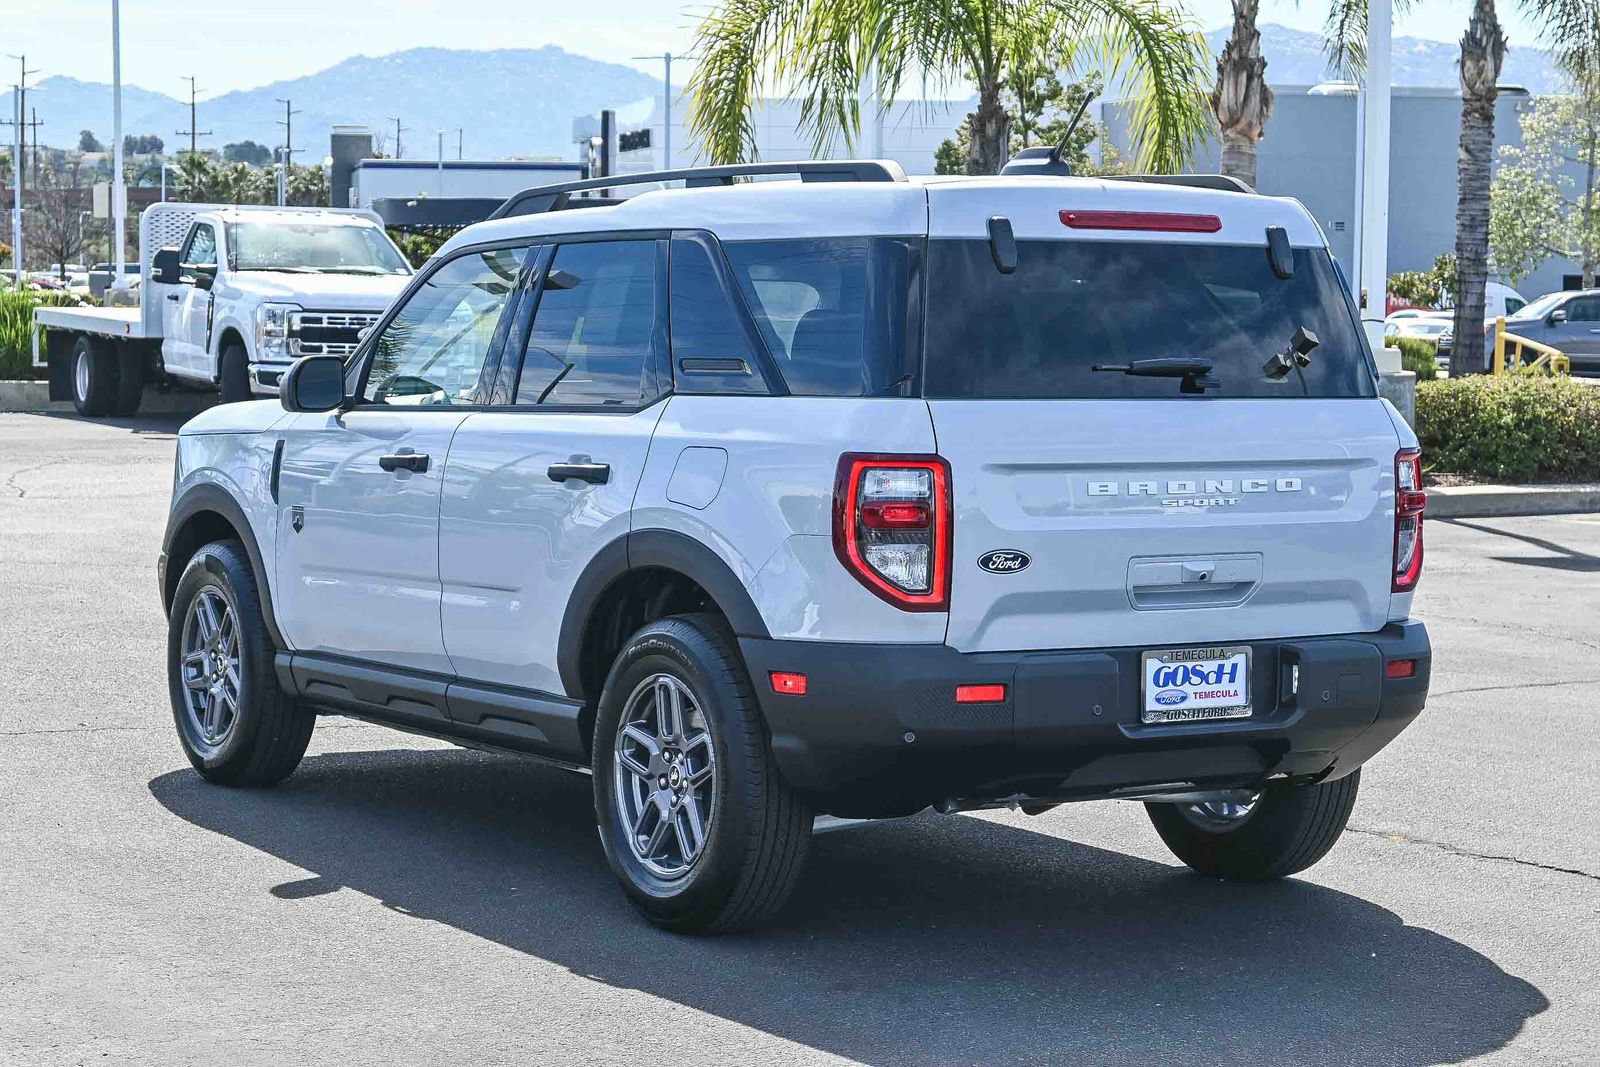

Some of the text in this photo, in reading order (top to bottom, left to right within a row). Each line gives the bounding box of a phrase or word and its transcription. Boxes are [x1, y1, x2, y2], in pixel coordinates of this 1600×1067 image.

[1087, 477, 1302, 496] BRONCO
[1161, 497, 1239, 508] SPORT
[988, 552, 1022, 569] Ford
[1168, 649, 1226, 661] TEMECULA
[1192, 689, 1239, 700] TEMECULA
